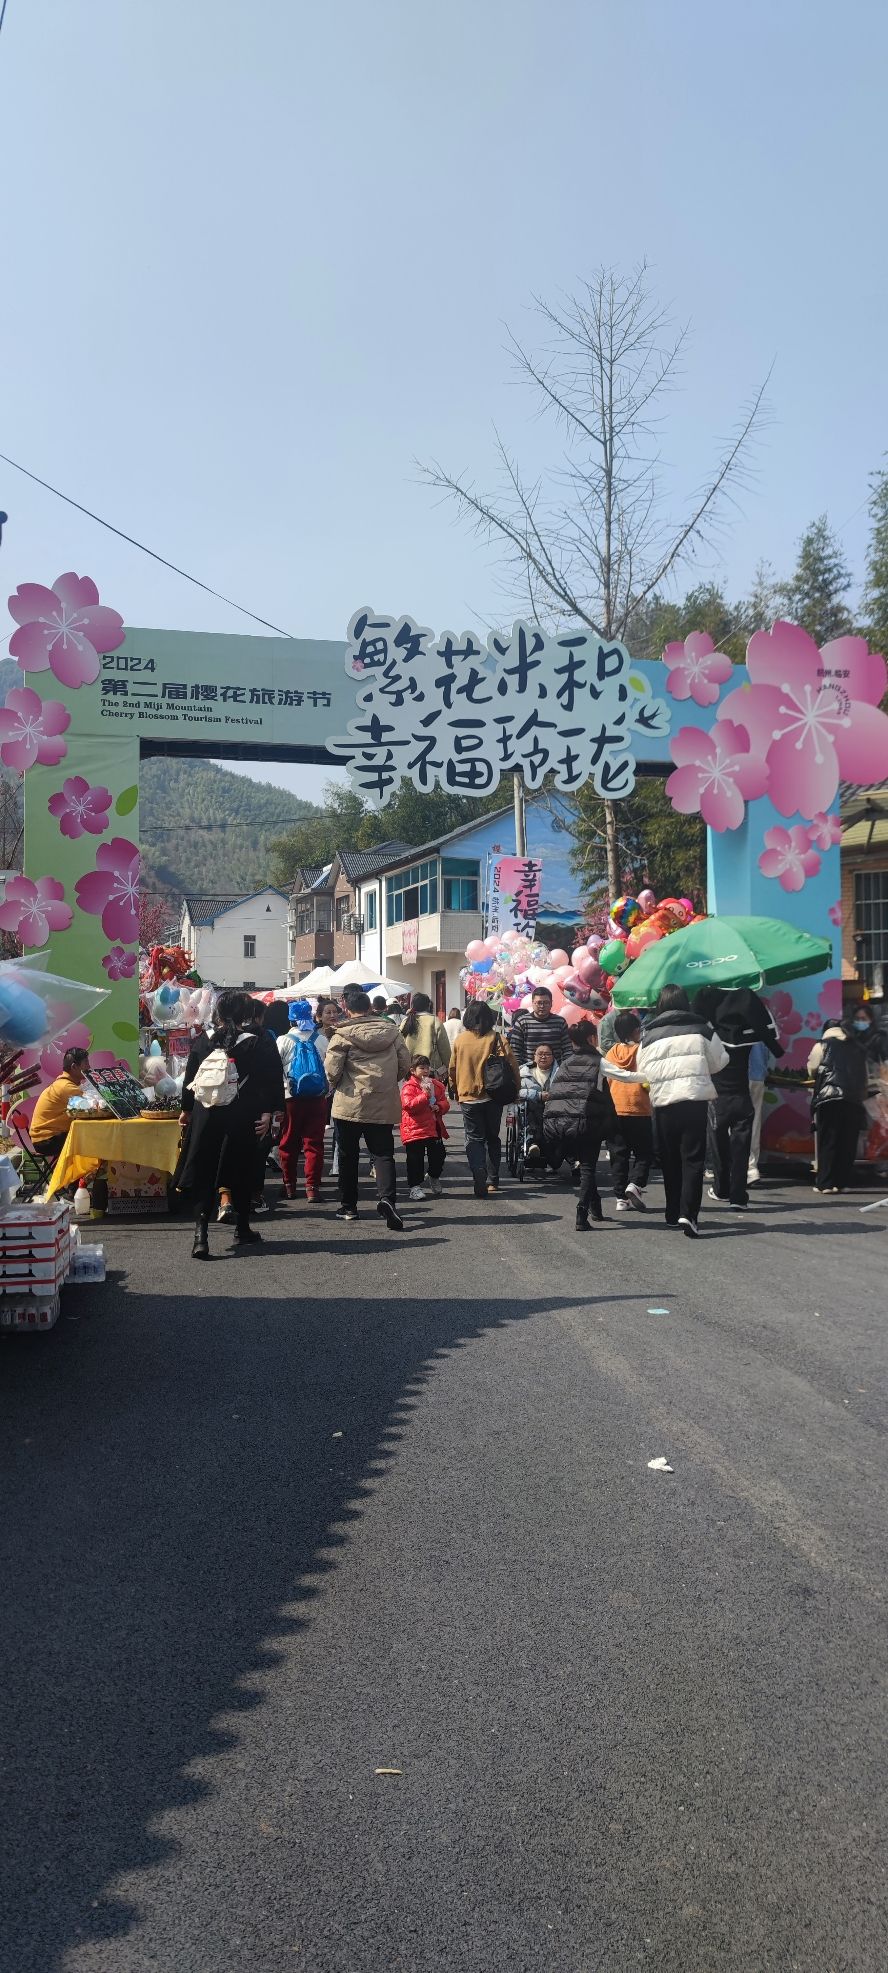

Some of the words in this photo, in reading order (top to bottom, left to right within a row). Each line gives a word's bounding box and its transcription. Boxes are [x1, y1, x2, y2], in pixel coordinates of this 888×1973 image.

[102, 655, 157, 673] 2024
[352, 613, 629, 712] 繁花米积
[100, 678, 333, 708] 第二届樱花旅游节
[100, 698, 119, 708] The
[122, 699, 141, 709] 2nd
[143, 700, 163, 712] Miji
[165, 701, 213, 713] Mountain
[100, 709, 135, 720] Cherry
[138, 710, 179, 721] Blossom
[181, 713, 222, 723] Tourism
[224, 715, 263, 726] Festival
[332, 708, 631, 800] 幸福玲珑
[492, 866, 502, 893] 2024
